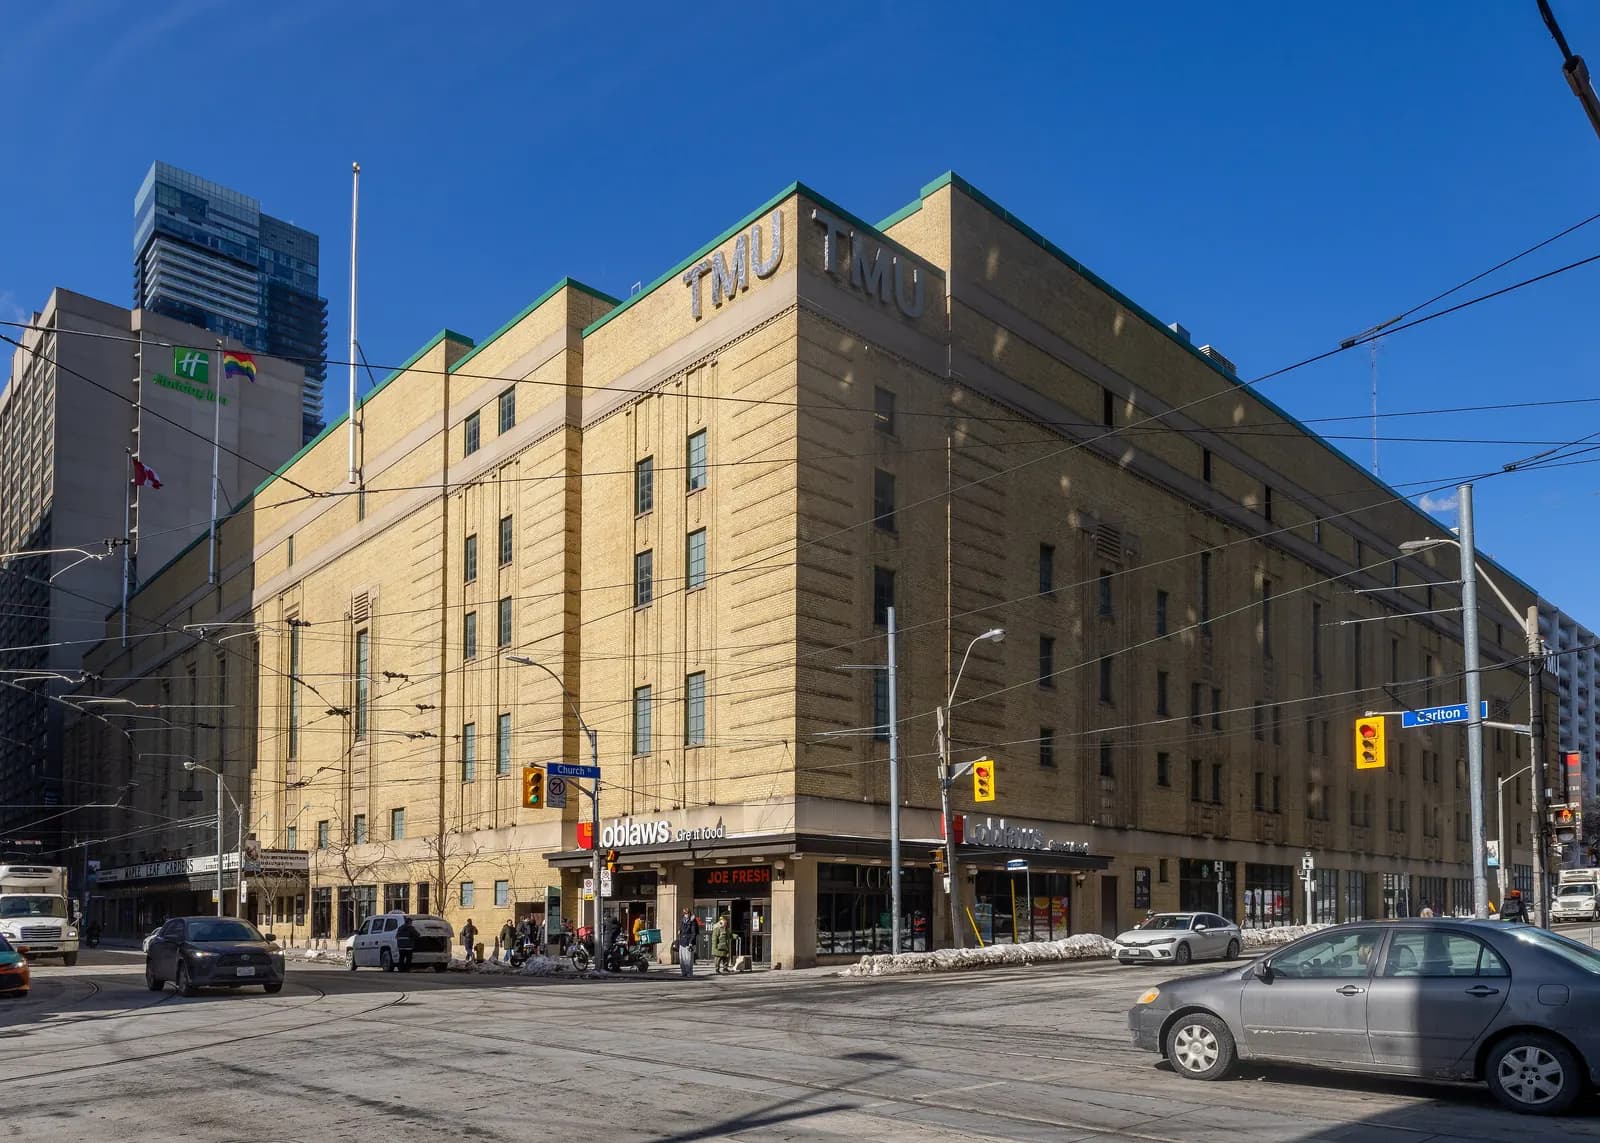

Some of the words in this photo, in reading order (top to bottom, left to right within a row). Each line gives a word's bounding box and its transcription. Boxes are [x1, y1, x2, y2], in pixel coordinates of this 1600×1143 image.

[683, 209, 783, 320] TMU
[812, 208, 924, 318] TMU
[1417, 709, 1461, 722] Carlton
[557, 765, 585, 775] Church
[599, 818, 671, 848] oblaws
[702, 824, 724, 840] food
[963, 815, 1046, 850] Loblaws
[146, 862, 160, 876] LEAF
[166, 859, 194, 875] GARDENS
[707, 870, 729, 884] JOE
[732, 869, 769, 884] FRESH
